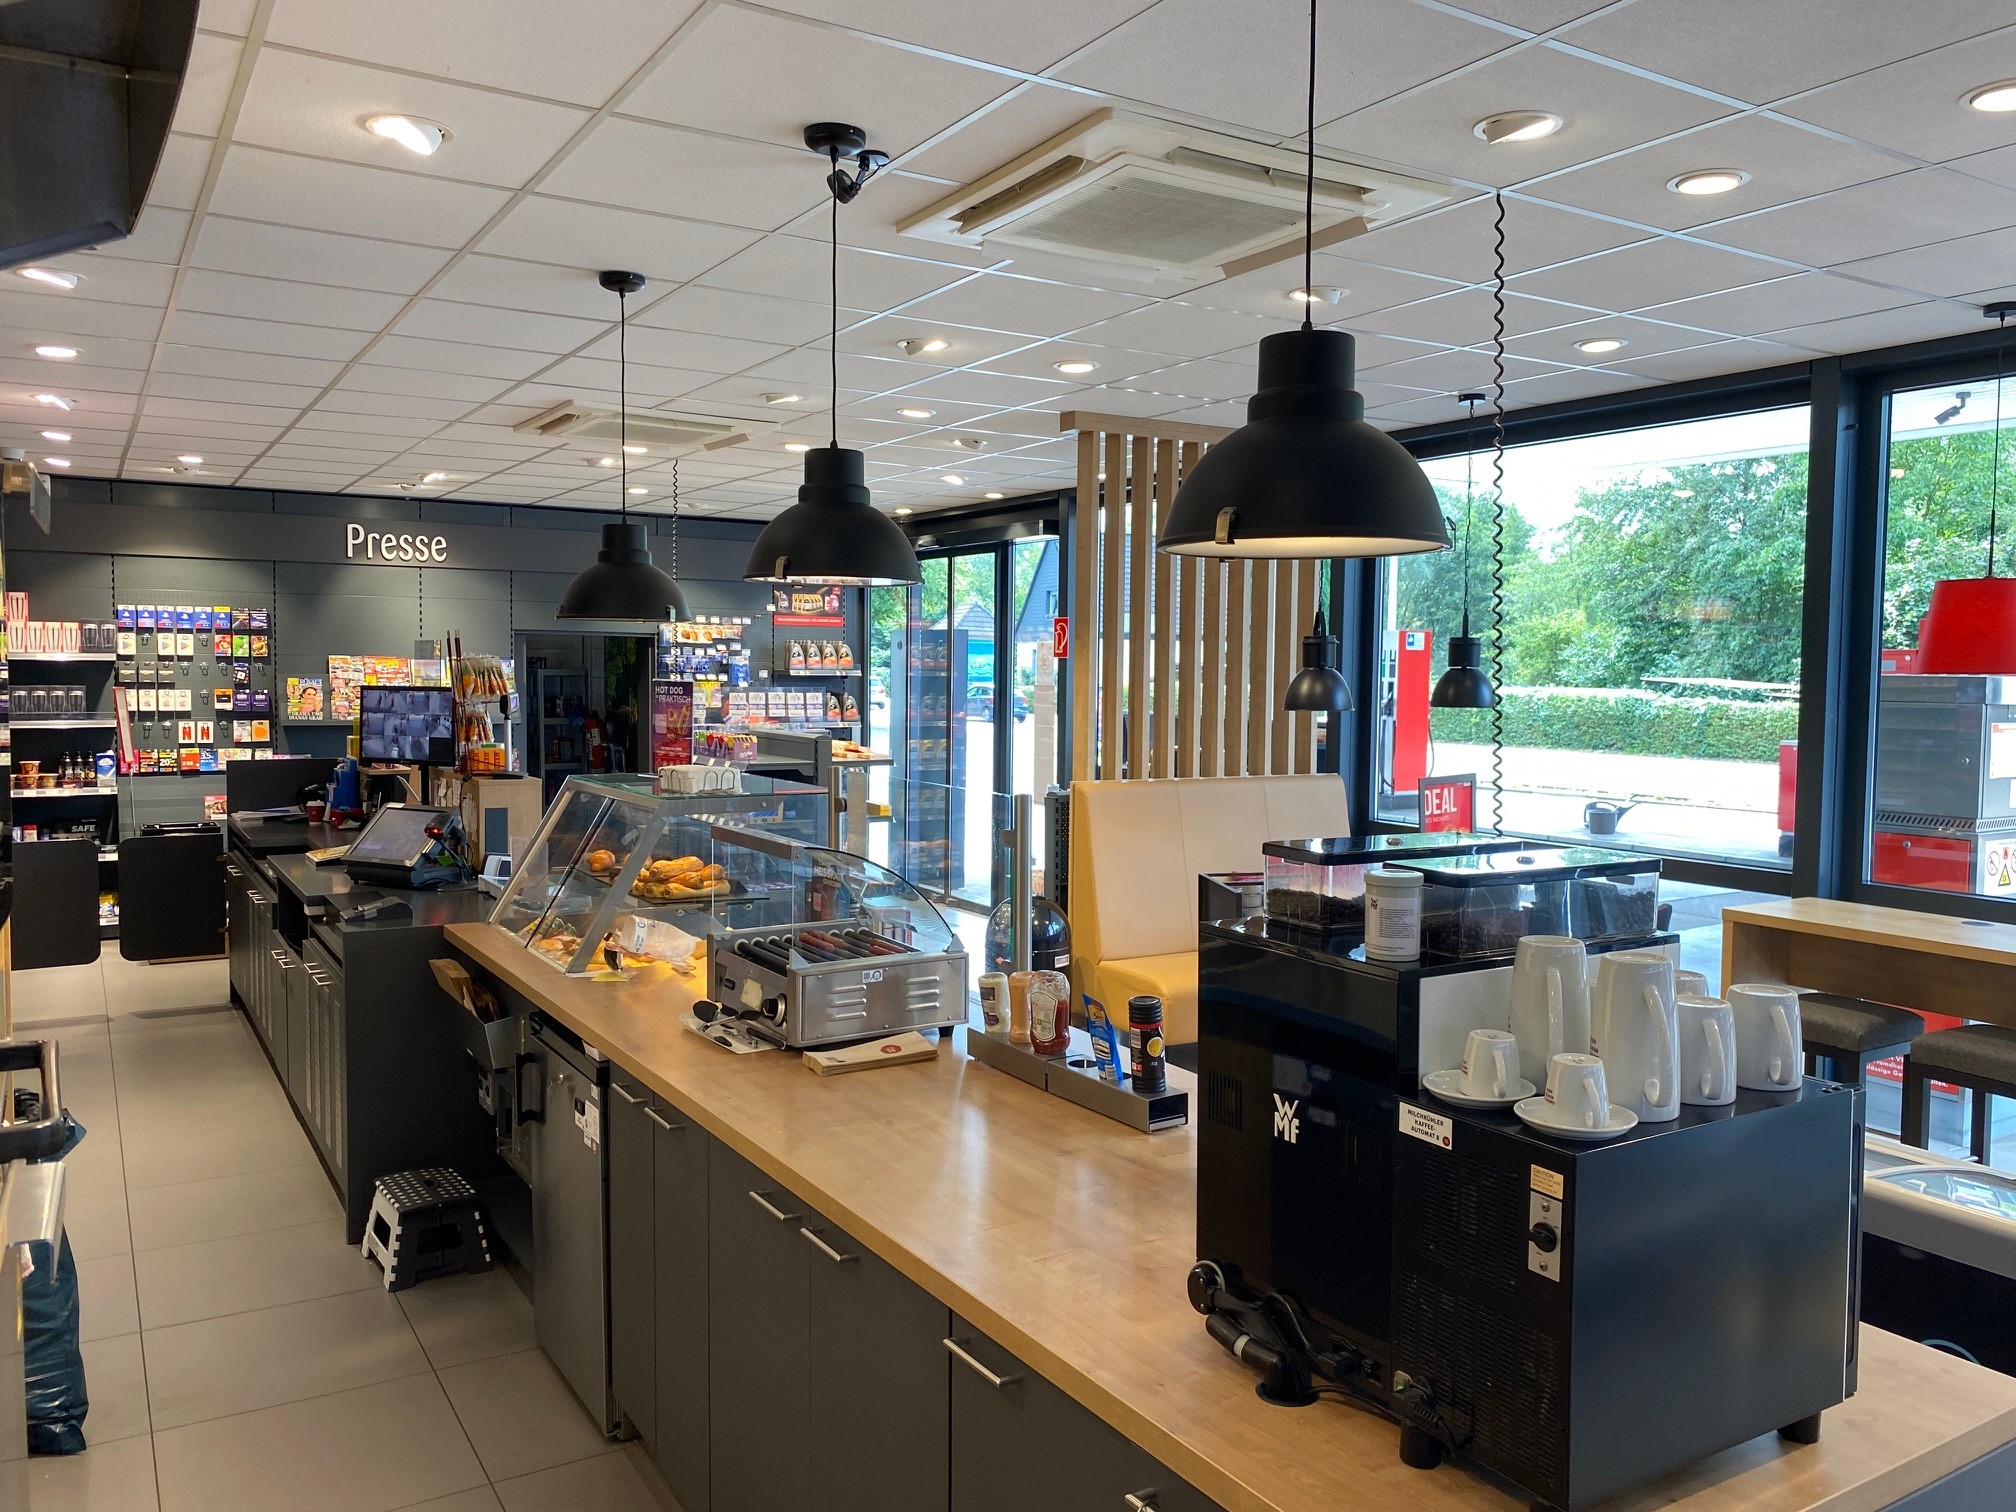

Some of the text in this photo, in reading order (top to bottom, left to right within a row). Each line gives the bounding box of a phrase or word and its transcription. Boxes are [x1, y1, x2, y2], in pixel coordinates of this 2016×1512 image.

[346, 523, 447, 562] Presse
[655, 685, 683, 695] HOT DOG
[658, 694, 691, 704] PRAKTISCH
[1424, 787, 1458, 816] DEAL
[71, 824, 96, 833] SAFE
[1407, 1108, 1444, 1127] MILCHKÜHLER
[1410, 1125, 1435, 1139] AUTOMAT
[1414, 1119, 1436, 1132] KAFFEE-
